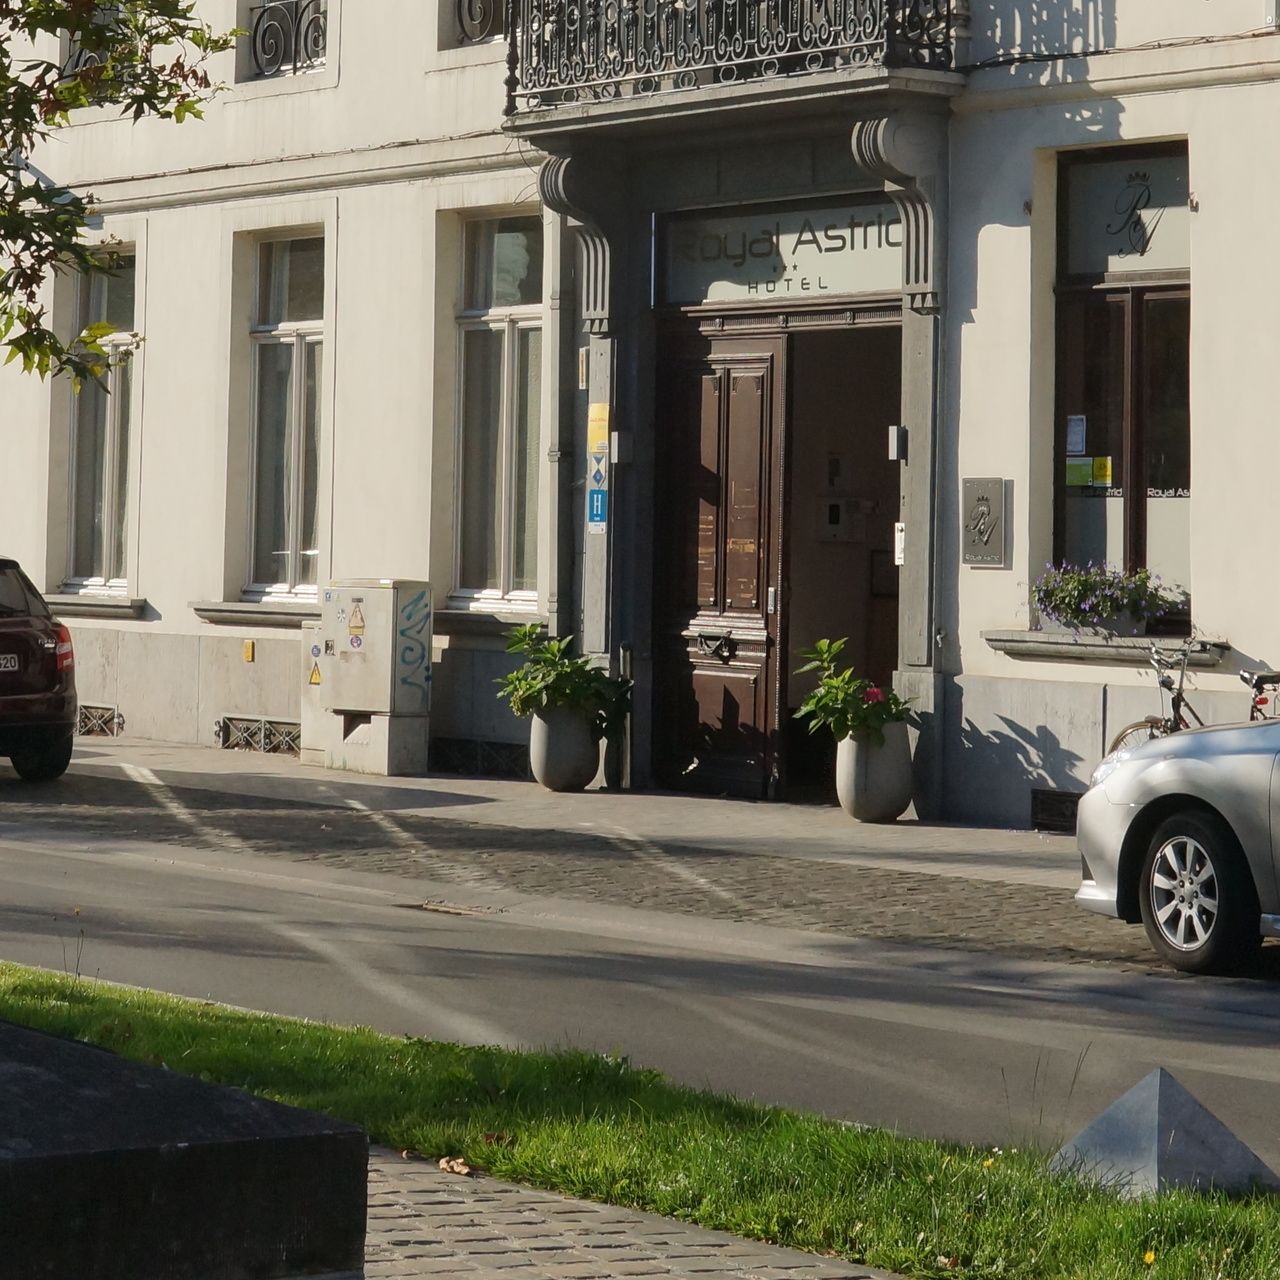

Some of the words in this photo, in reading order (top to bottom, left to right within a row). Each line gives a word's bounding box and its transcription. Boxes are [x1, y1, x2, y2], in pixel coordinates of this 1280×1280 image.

[748, 276, 828, 294] HOTEL
[1147, 488, 1175, 497] Royal
[1176, 488, 1191, 497] As
